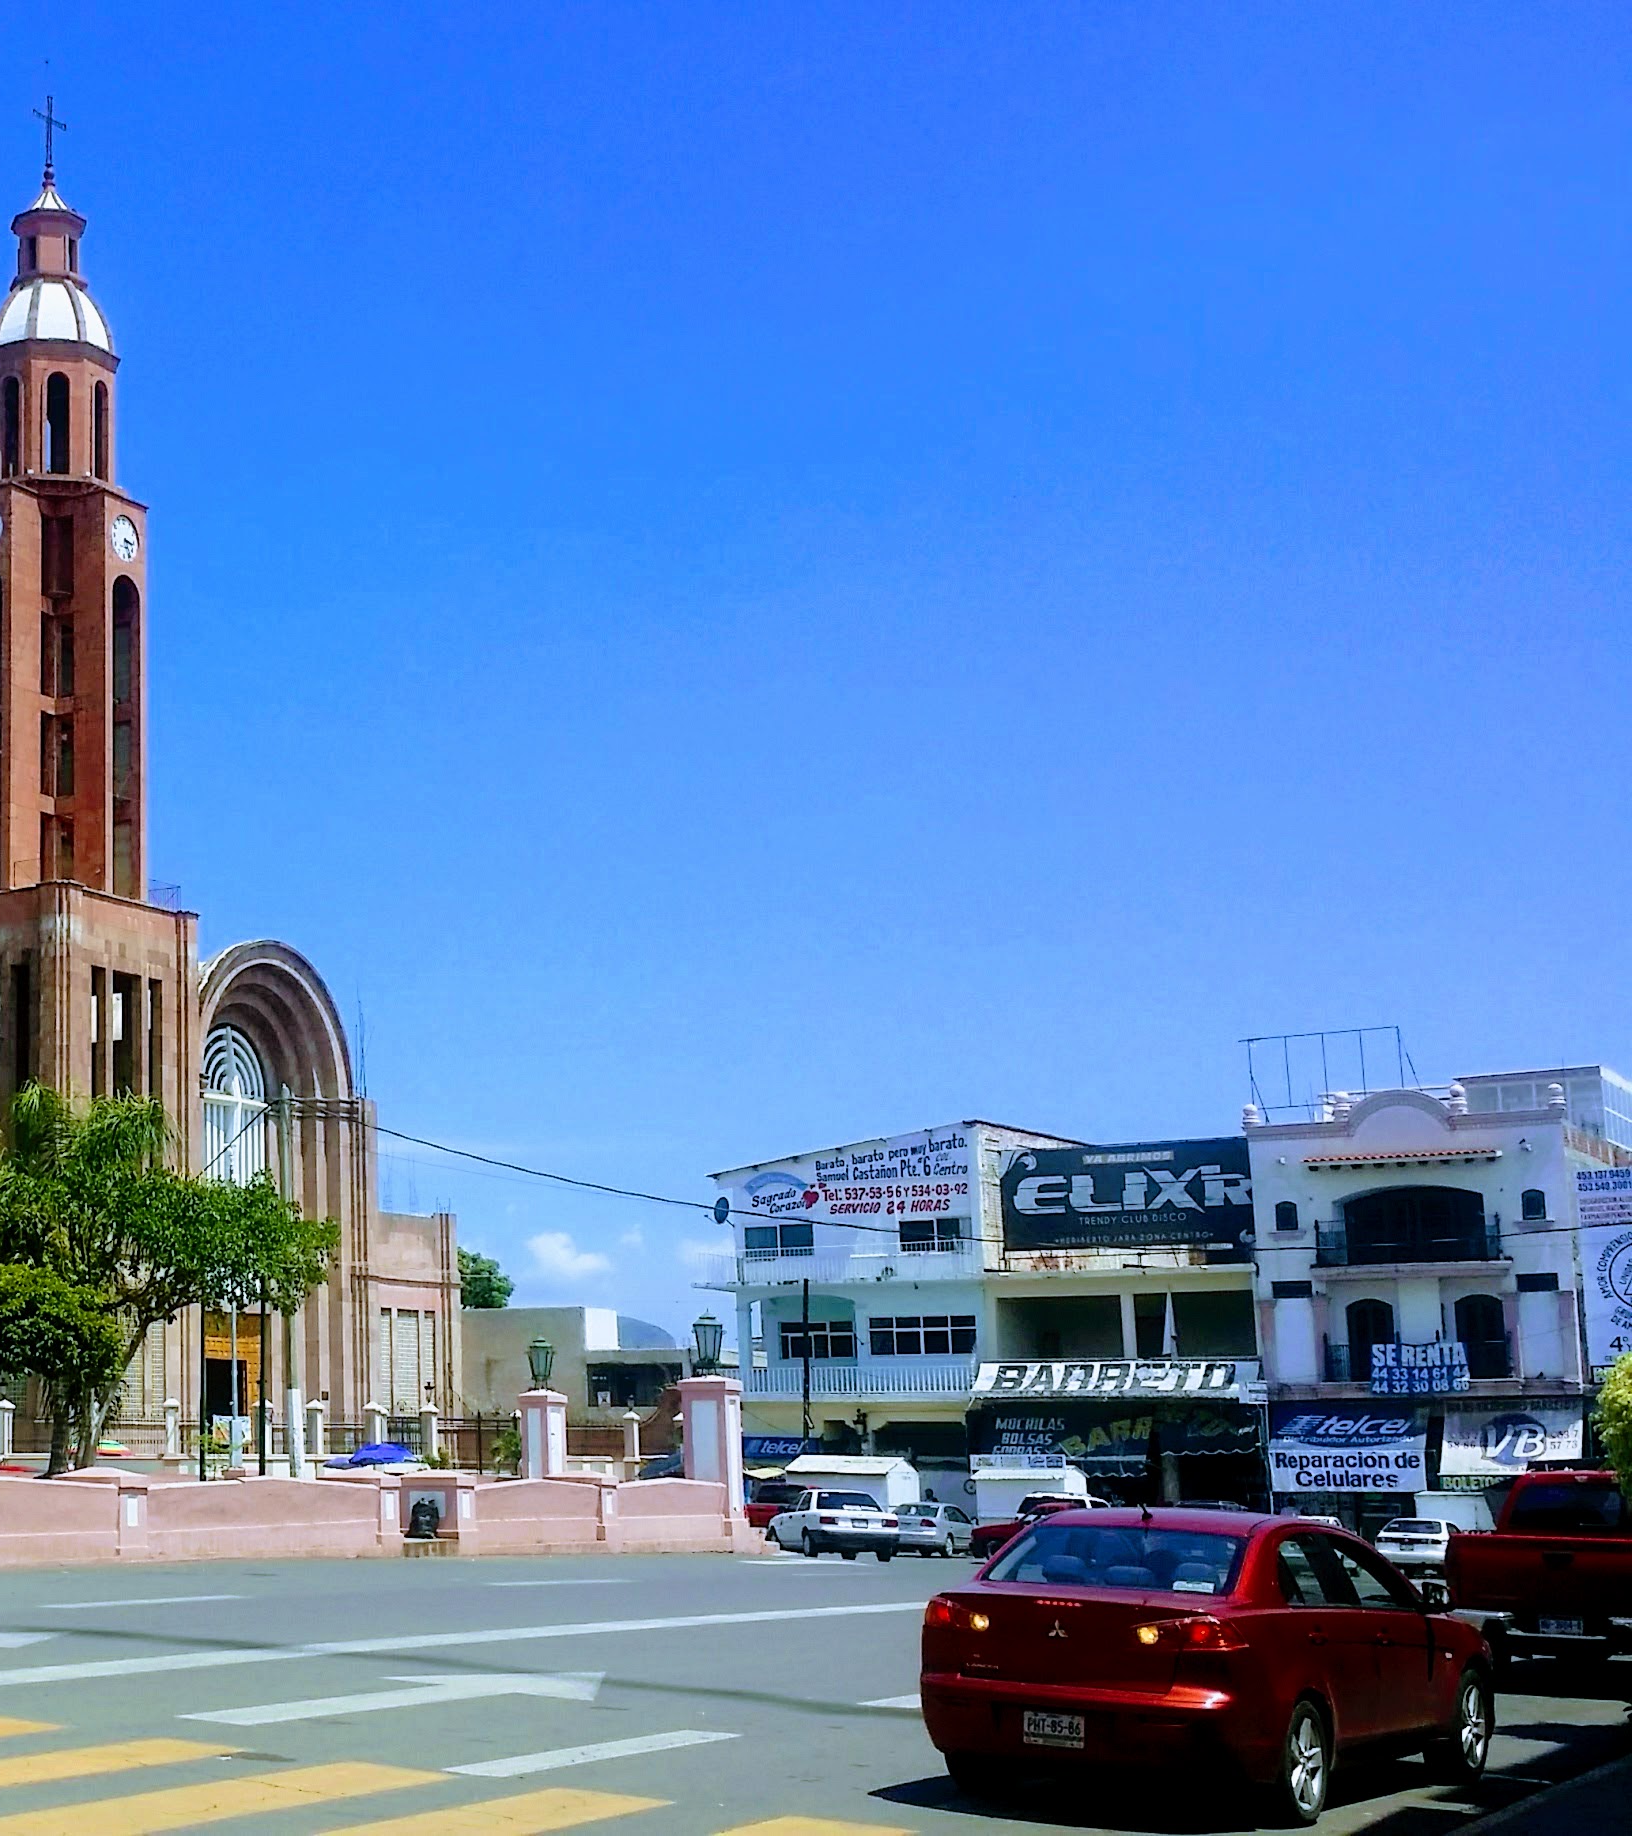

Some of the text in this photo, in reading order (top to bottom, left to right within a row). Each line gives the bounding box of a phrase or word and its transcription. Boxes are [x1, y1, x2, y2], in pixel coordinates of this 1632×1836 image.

[851, 1149, 884, 1165] barato
[888, 1147, 908, 1161] pero
[1084, 1151, 1170, 1164] YA ABRIMOS
[816, 1165, 849, 1182] Samuel
[933, 1161, 968, 1176] Centro
[751, 1187, 797, 1208] Sagrado
[829, 1199, 951, 1215] SERVICIO 24 HORAS
[1079, 1215, 1117, 1226] TRENDY
[1121, 1214, 1149, 1224] CLUB
[1113, 1235, 1136, 1243] JARA
[1372, 1341, 1468, 1367] SE RENTA
[1372, 1367, 1388, 1379] 44
[1392, 1368, 1408, 1380] 33
[1412, 1368, 1429, 1380] 14
[1432, 1366, 1448, 1379] 61
[1372, 1380, 1389, 1394] 44
[1392, 1380, 1409, 1394] 32
[1412, 1381, 1429, 1393] 30
[1432, 1379, 1449, 1392] 08
[995, 1417, 1065, 1431] MOCHILAS
[1001, 1432, 1054, 1445] BOLSAS
[1485, 1423, 1546, 1458] VB
[760, 1440, 808, 1454] telcel
[1275, 1451, 1421, 1471] Reparación de
[1295, 1470, 1400, 1488] Celulares
